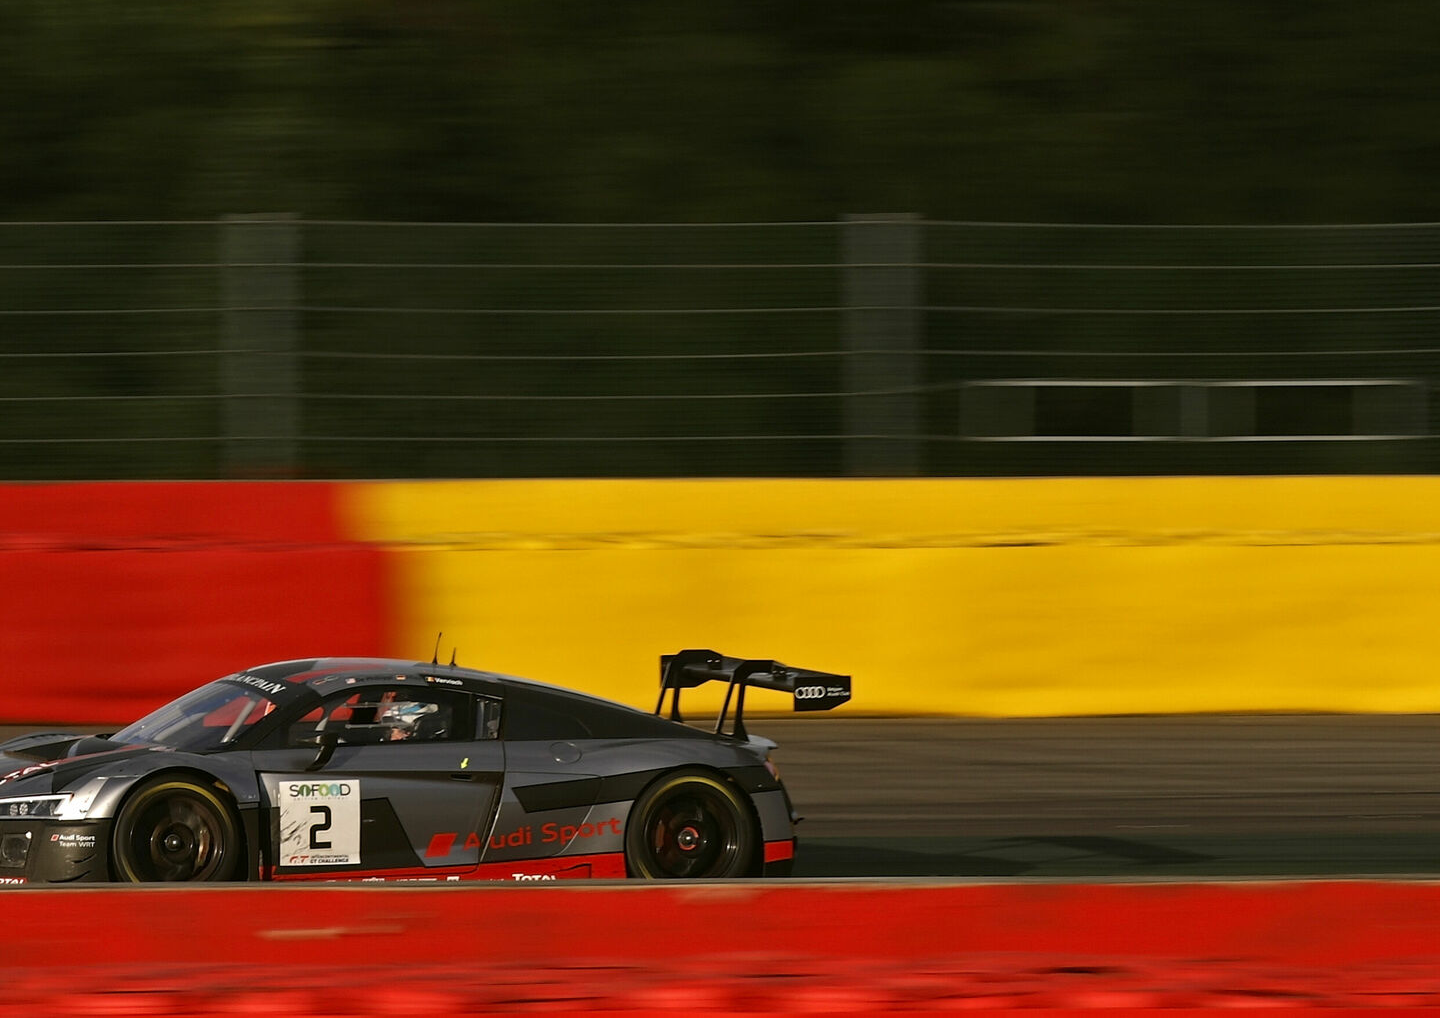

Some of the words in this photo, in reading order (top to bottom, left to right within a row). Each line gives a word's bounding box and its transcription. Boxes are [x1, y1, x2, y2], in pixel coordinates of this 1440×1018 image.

[289, 783, 351, 797] SOFOOD
[76, 834, 96, 842] Sport
[309, 805, 332, 850] 2
[463, 826, 532, 851] Audi
[541, 817, 624, 845] Sport
